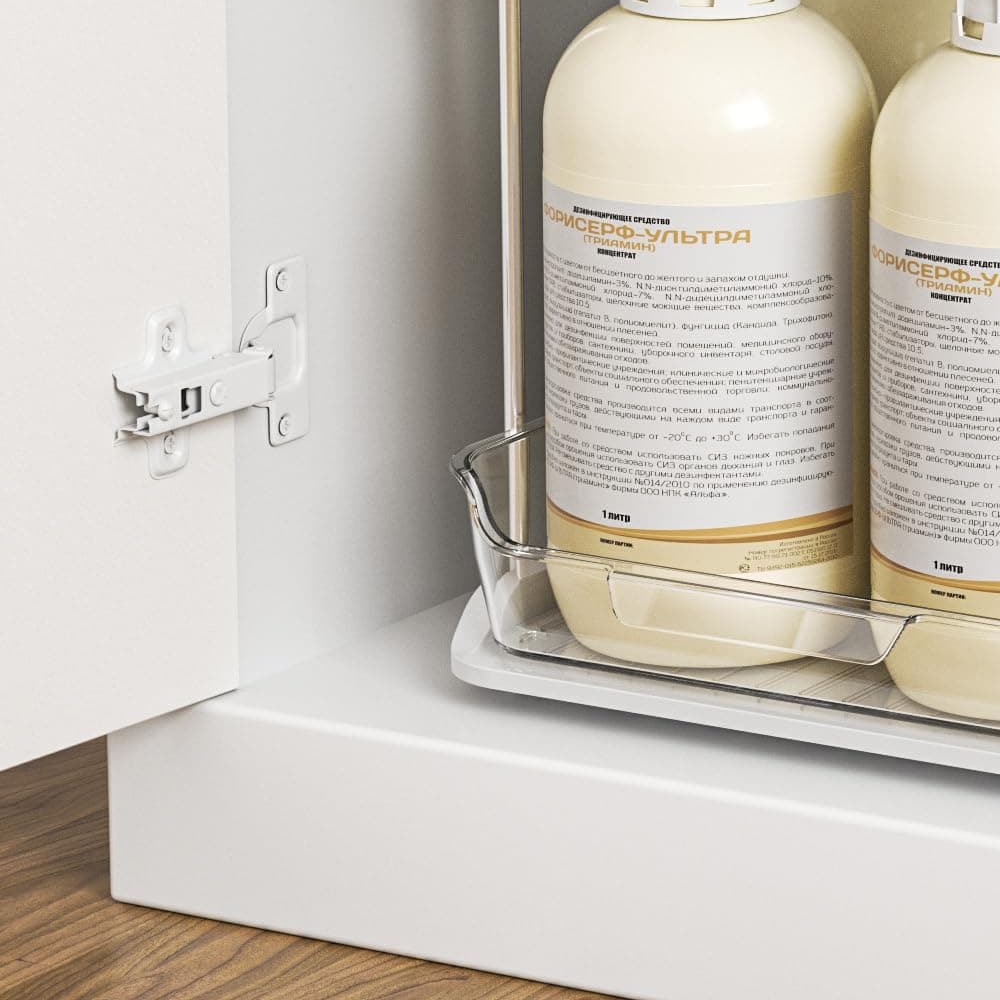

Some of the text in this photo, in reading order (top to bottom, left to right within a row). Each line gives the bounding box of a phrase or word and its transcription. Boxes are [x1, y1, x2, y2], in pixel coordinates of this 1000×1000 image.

[634, 216, 671, 225] СРЕДСТВО
[583, 234, 656, 253] (ТРИАМИН)
[597, 247, 637, 260] КОНЦЕНТРАТ
[916, 278, 993, 297] (ТРИАМИН)
[930, 291, 972, 304] КОНЦЕНТРАТ
[608, 511, 631, 523] литр
[939, 562, 964, 574] литр
